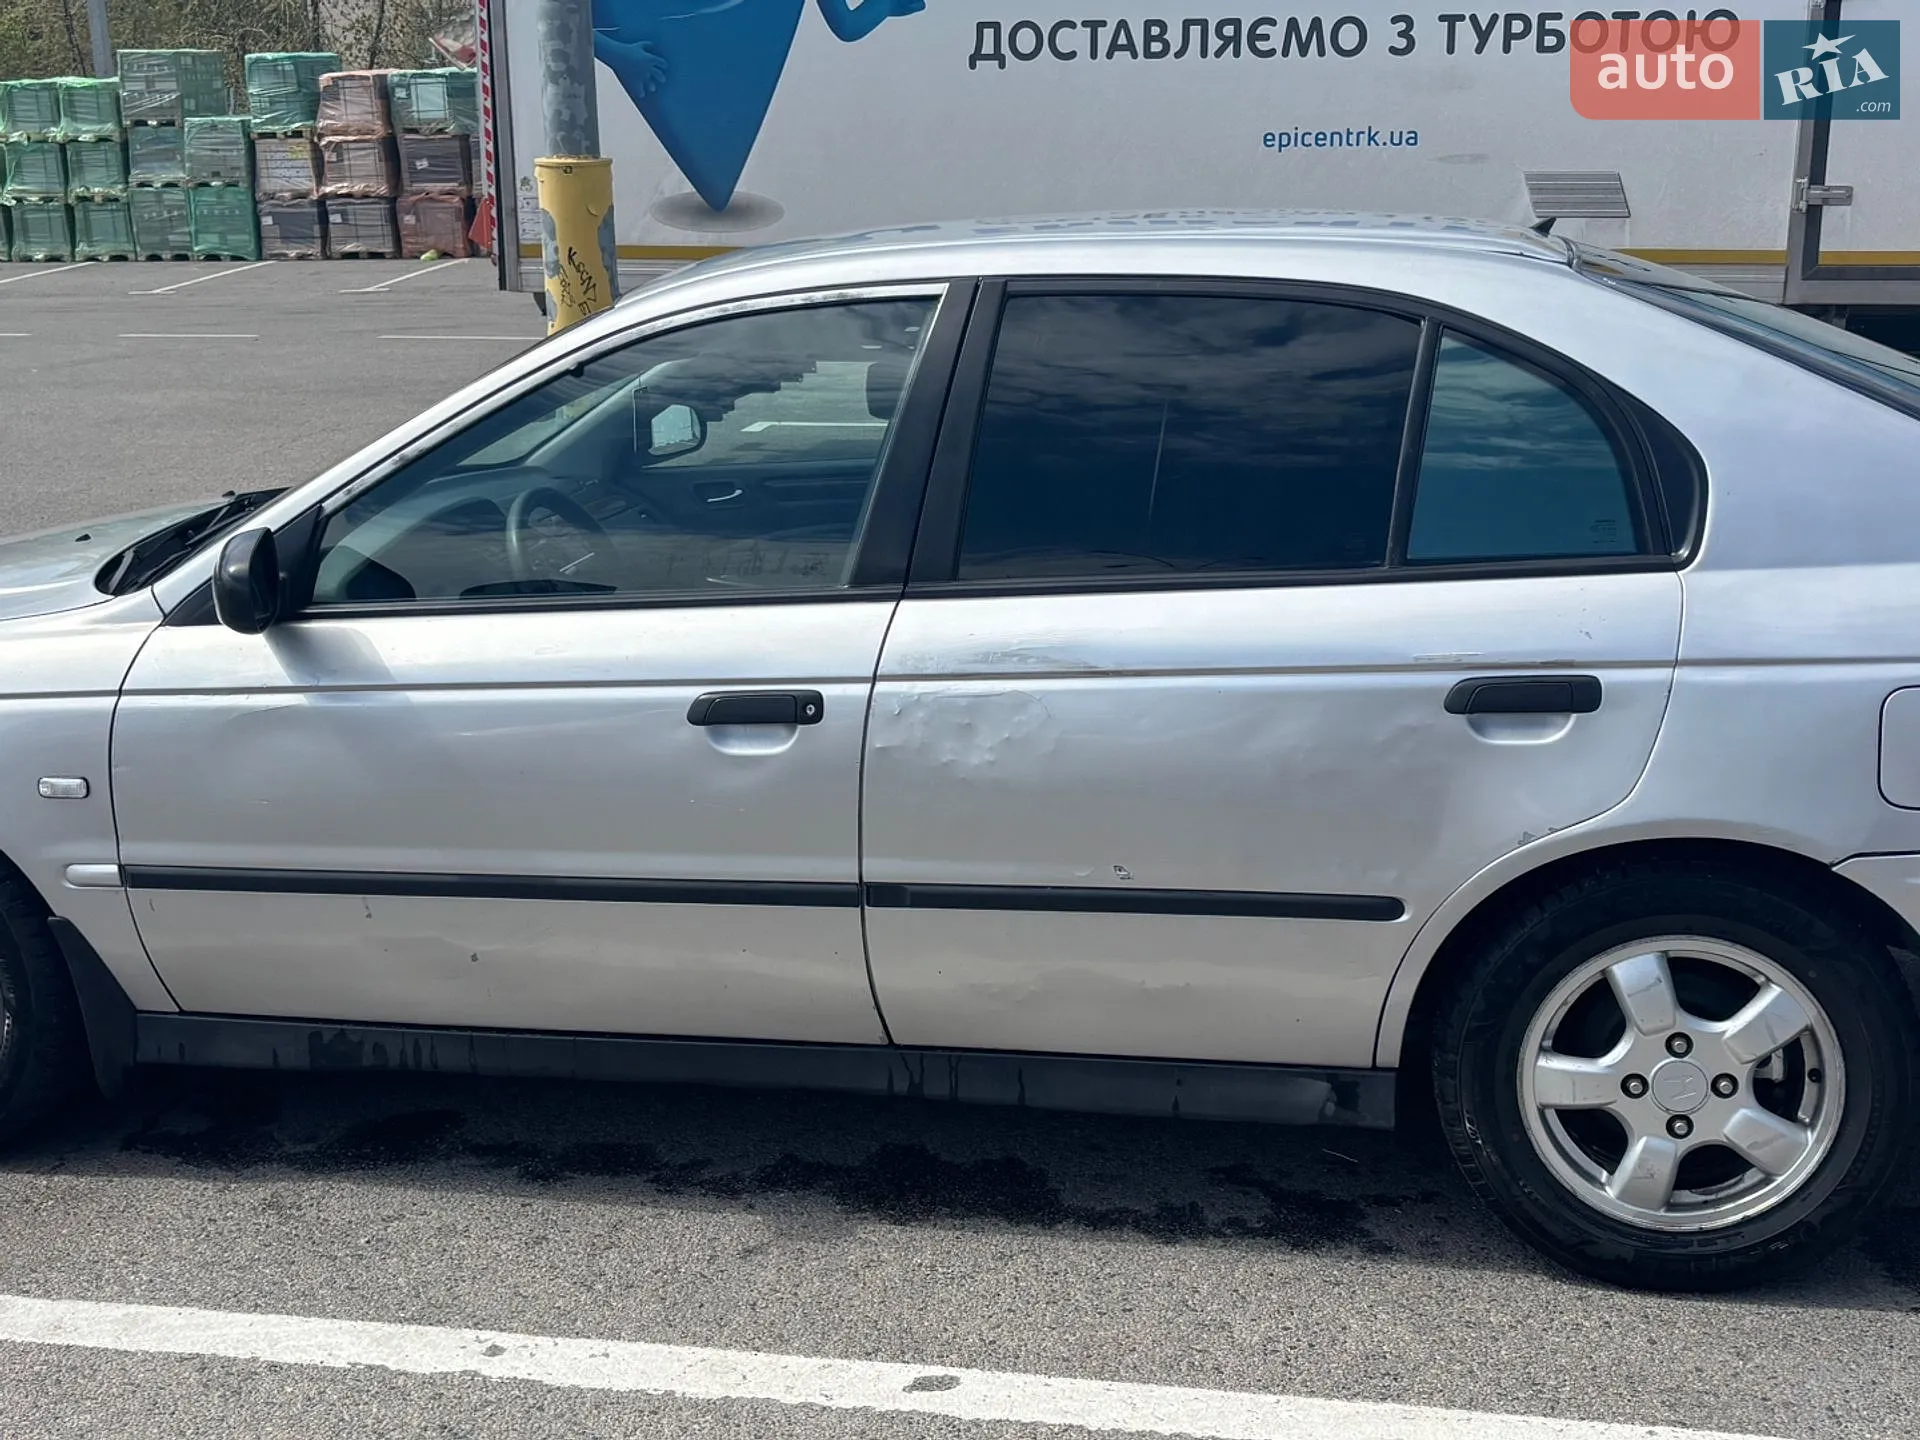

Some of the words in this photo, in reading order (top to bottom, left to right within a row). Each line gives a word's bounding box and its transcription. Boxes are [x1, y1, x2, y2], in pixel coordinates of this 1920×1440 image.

[968, 16, 1368, 70] ДОСТАВЛЯЄМО
[1438, 9, 1741, 55] ТУРБОТОЮ
[1262, 126, 1419, 152] epicentrk.ua
